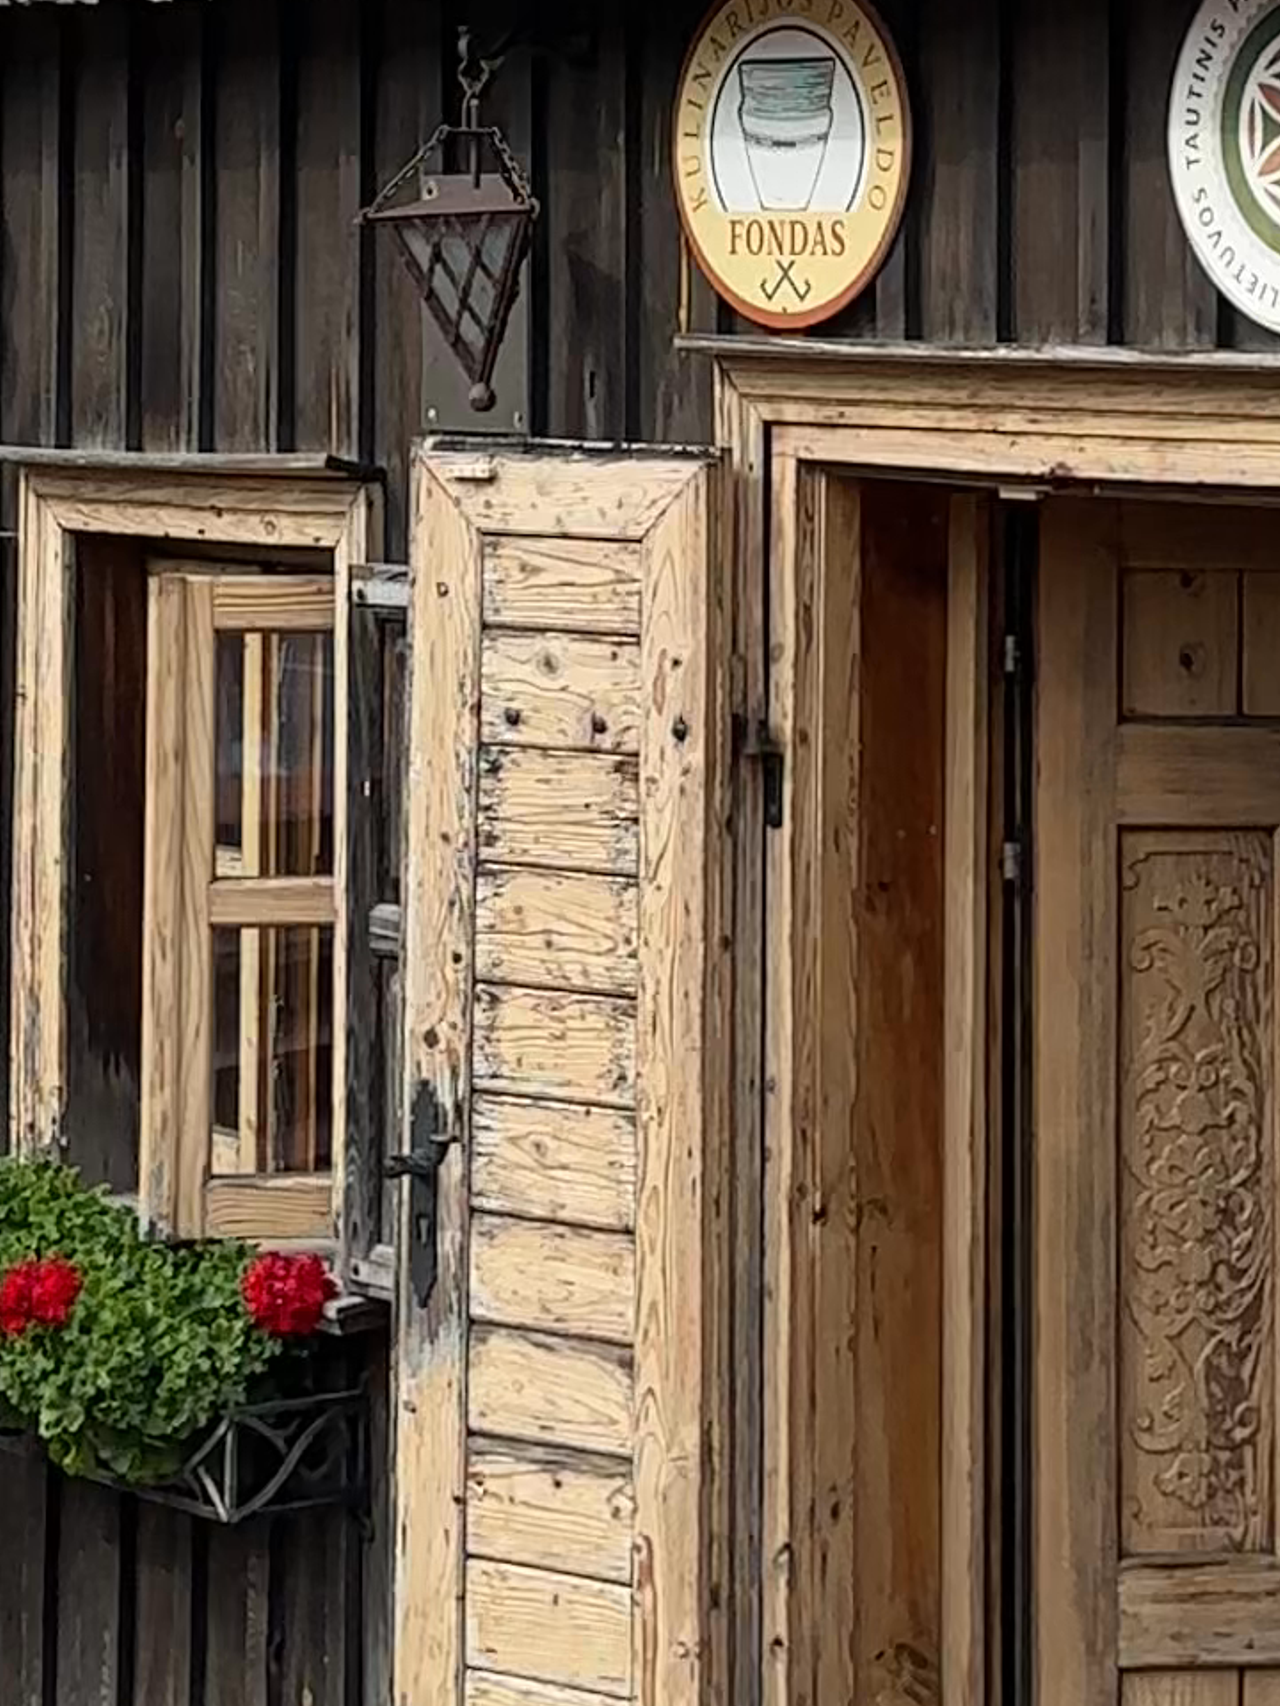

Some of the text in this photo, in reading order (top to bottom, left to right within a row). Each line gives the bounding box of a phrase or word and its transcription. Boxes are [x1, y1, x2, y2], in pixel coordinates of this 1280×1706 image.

[1185, 19, 1226, 171] TAUTINIS
[729, 218, 847, 257] FONDAS
[1191, 186, 1280, 310] LIETUVOS
